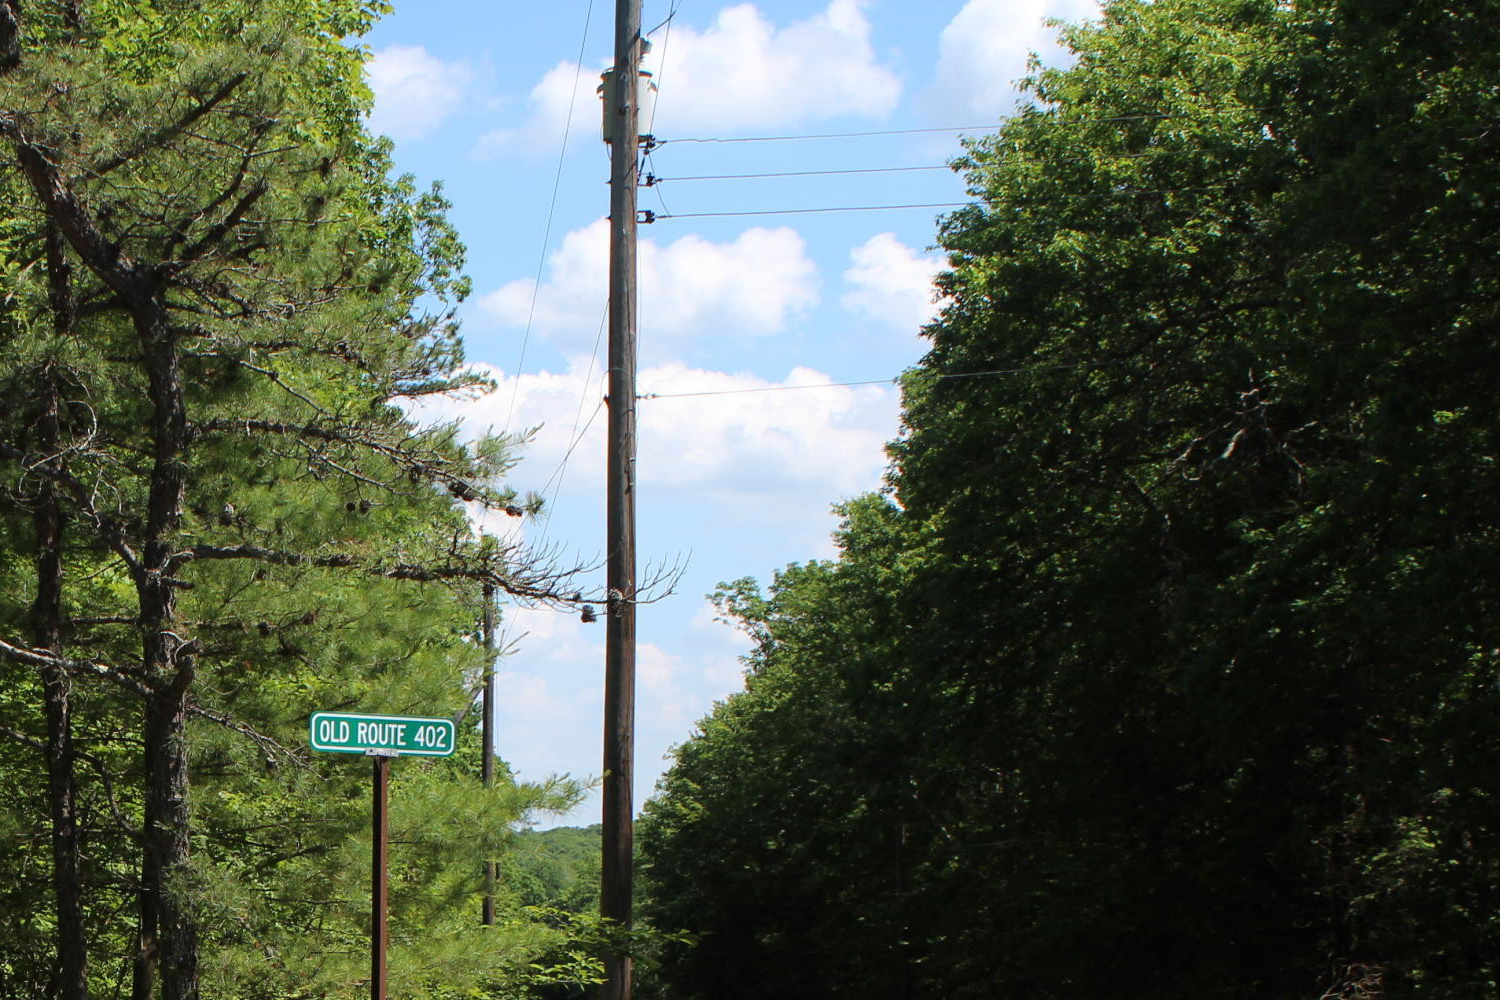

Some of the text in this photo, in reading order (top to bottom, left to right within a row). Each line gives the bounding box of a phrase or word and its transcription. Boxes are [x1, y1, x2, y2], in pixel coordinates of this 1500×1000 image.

[319, 720, 447, 748] OLD ROUTE 402
